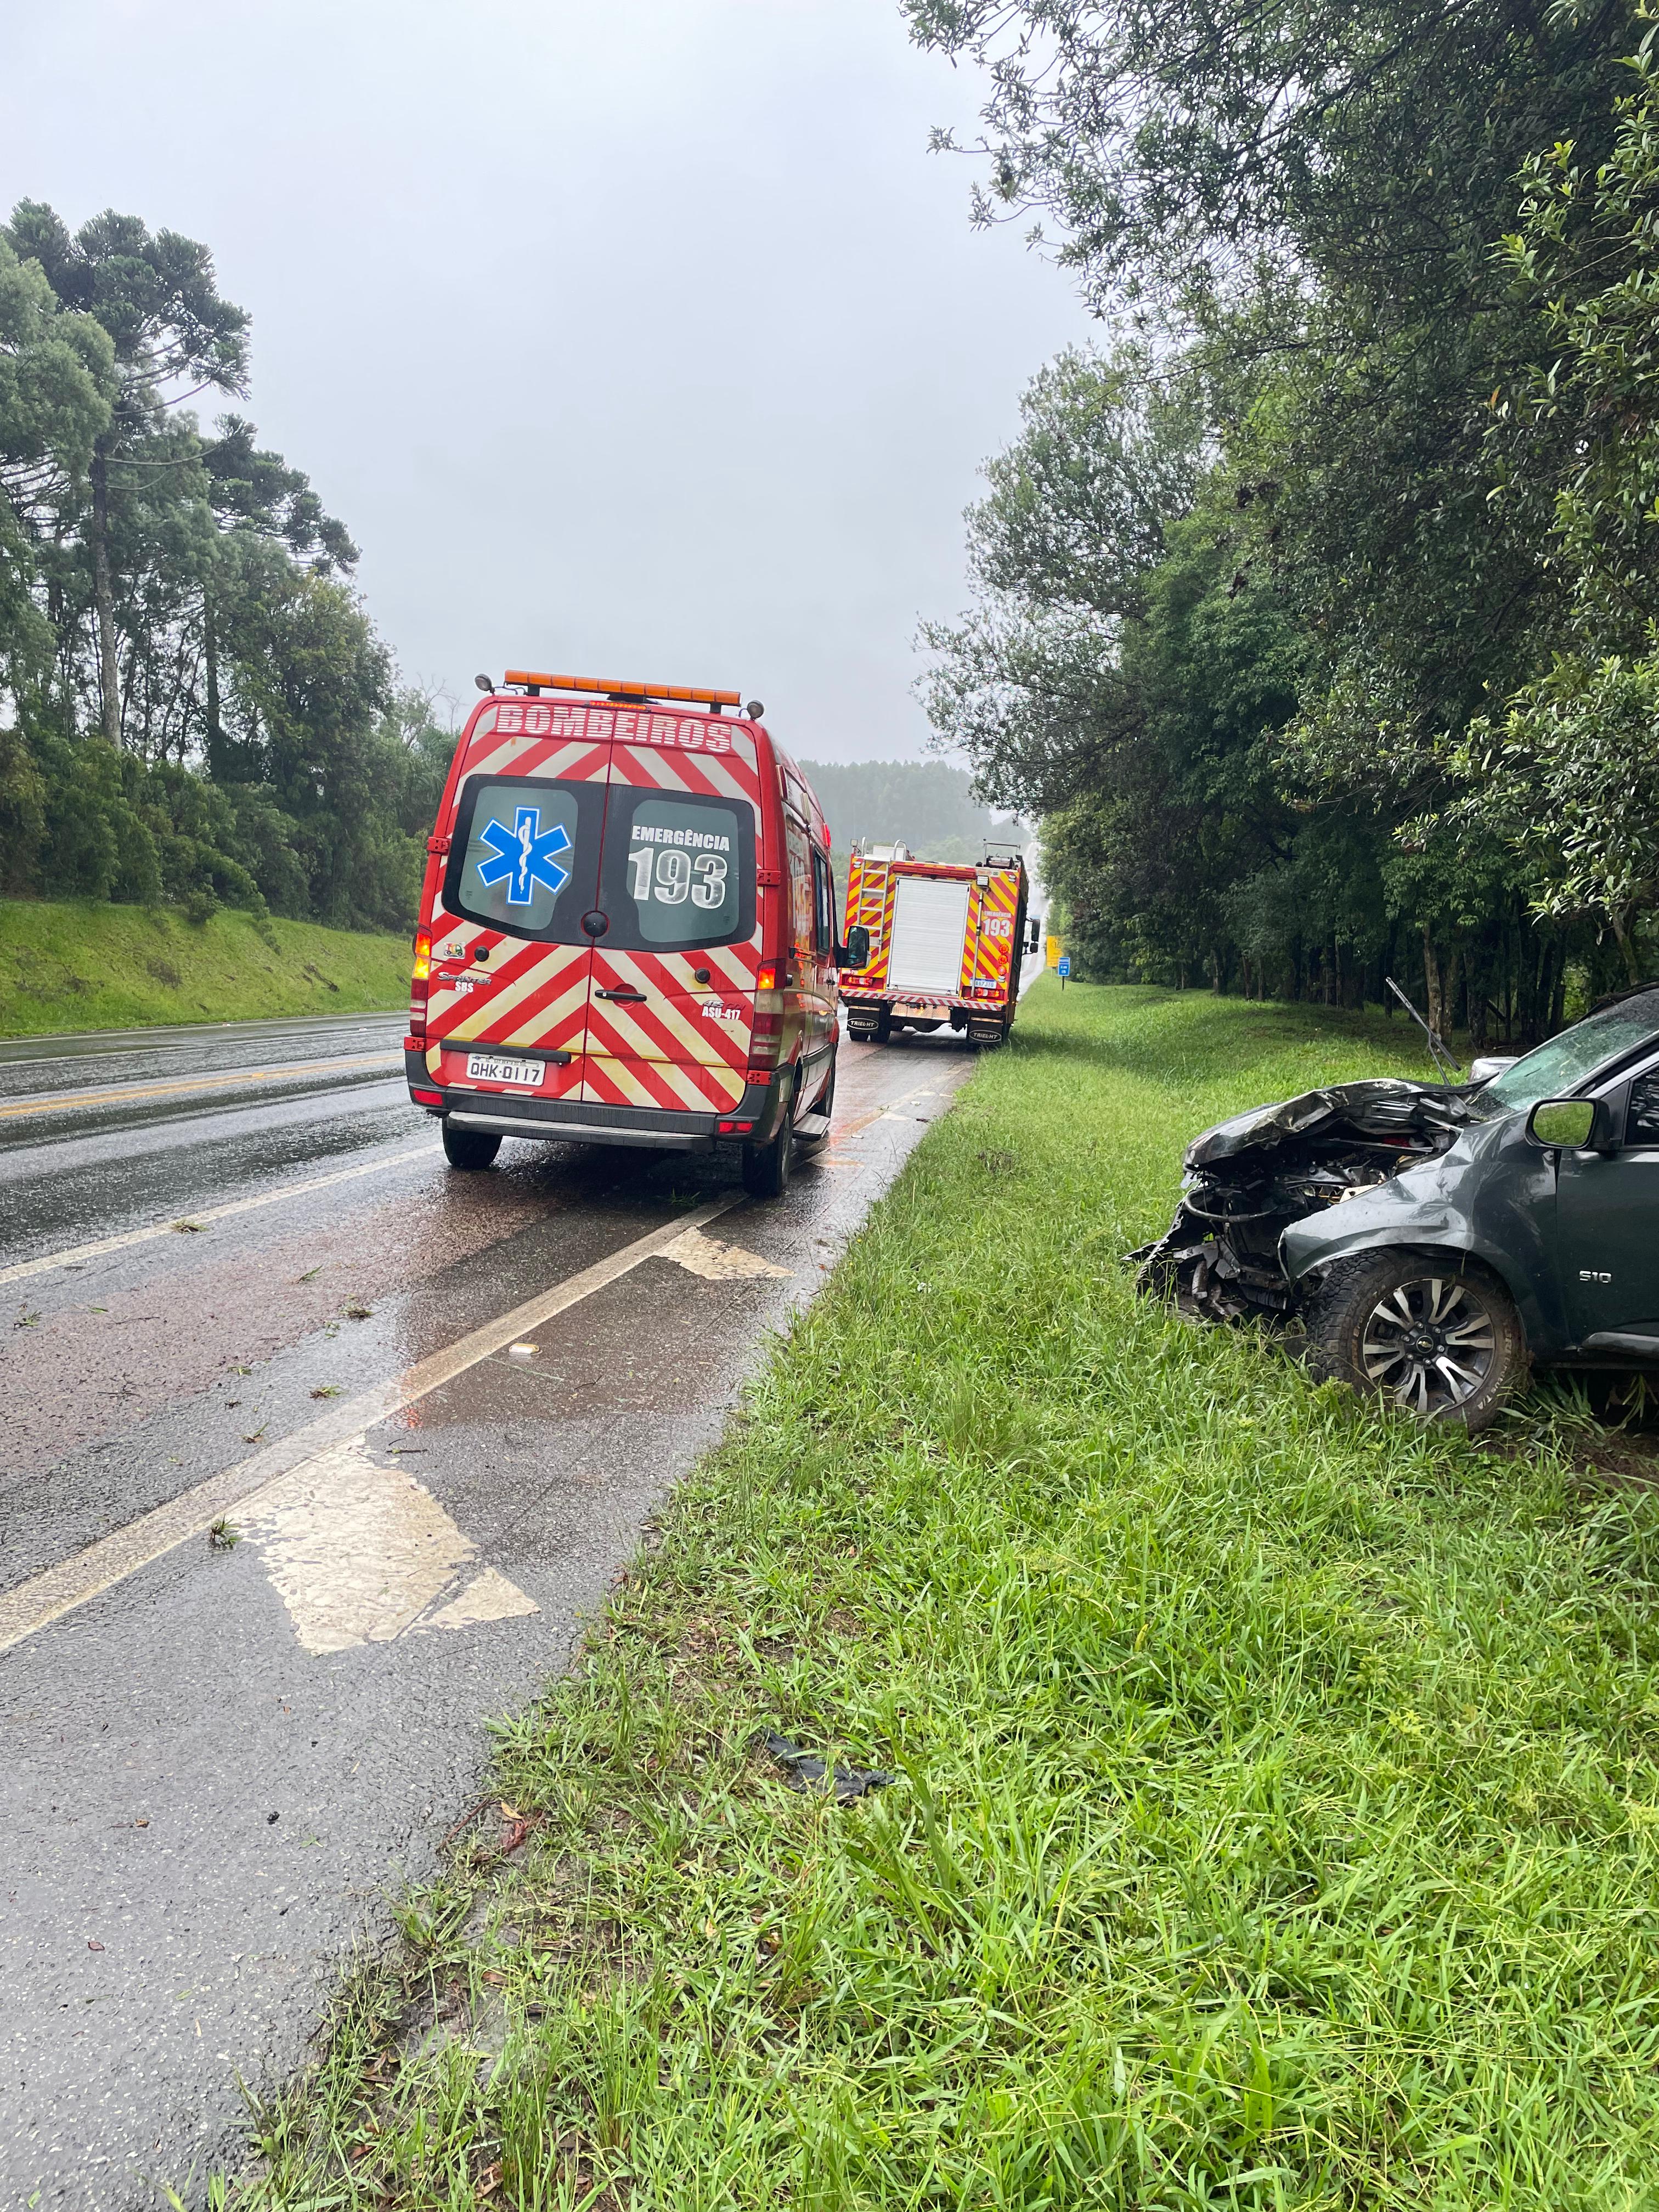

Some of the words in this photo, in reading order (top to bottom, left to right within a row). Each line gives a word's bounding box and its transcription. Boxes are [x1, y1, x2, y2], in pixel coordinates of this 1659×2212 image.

[496, 704, 731, 753] BOMBEIROS
[631, 825, 730, 851] EMERGÊNCIA
[628, 847, 727, 909] 193
[983, 918, 1011, 937] 193
[437, 972, 492, 985] SPRINTER
[455, 981, 474, 992] SBS
[702, 1006, 741, 1020] ASU-417
[1579, 1270, 1612, 1283] S10
